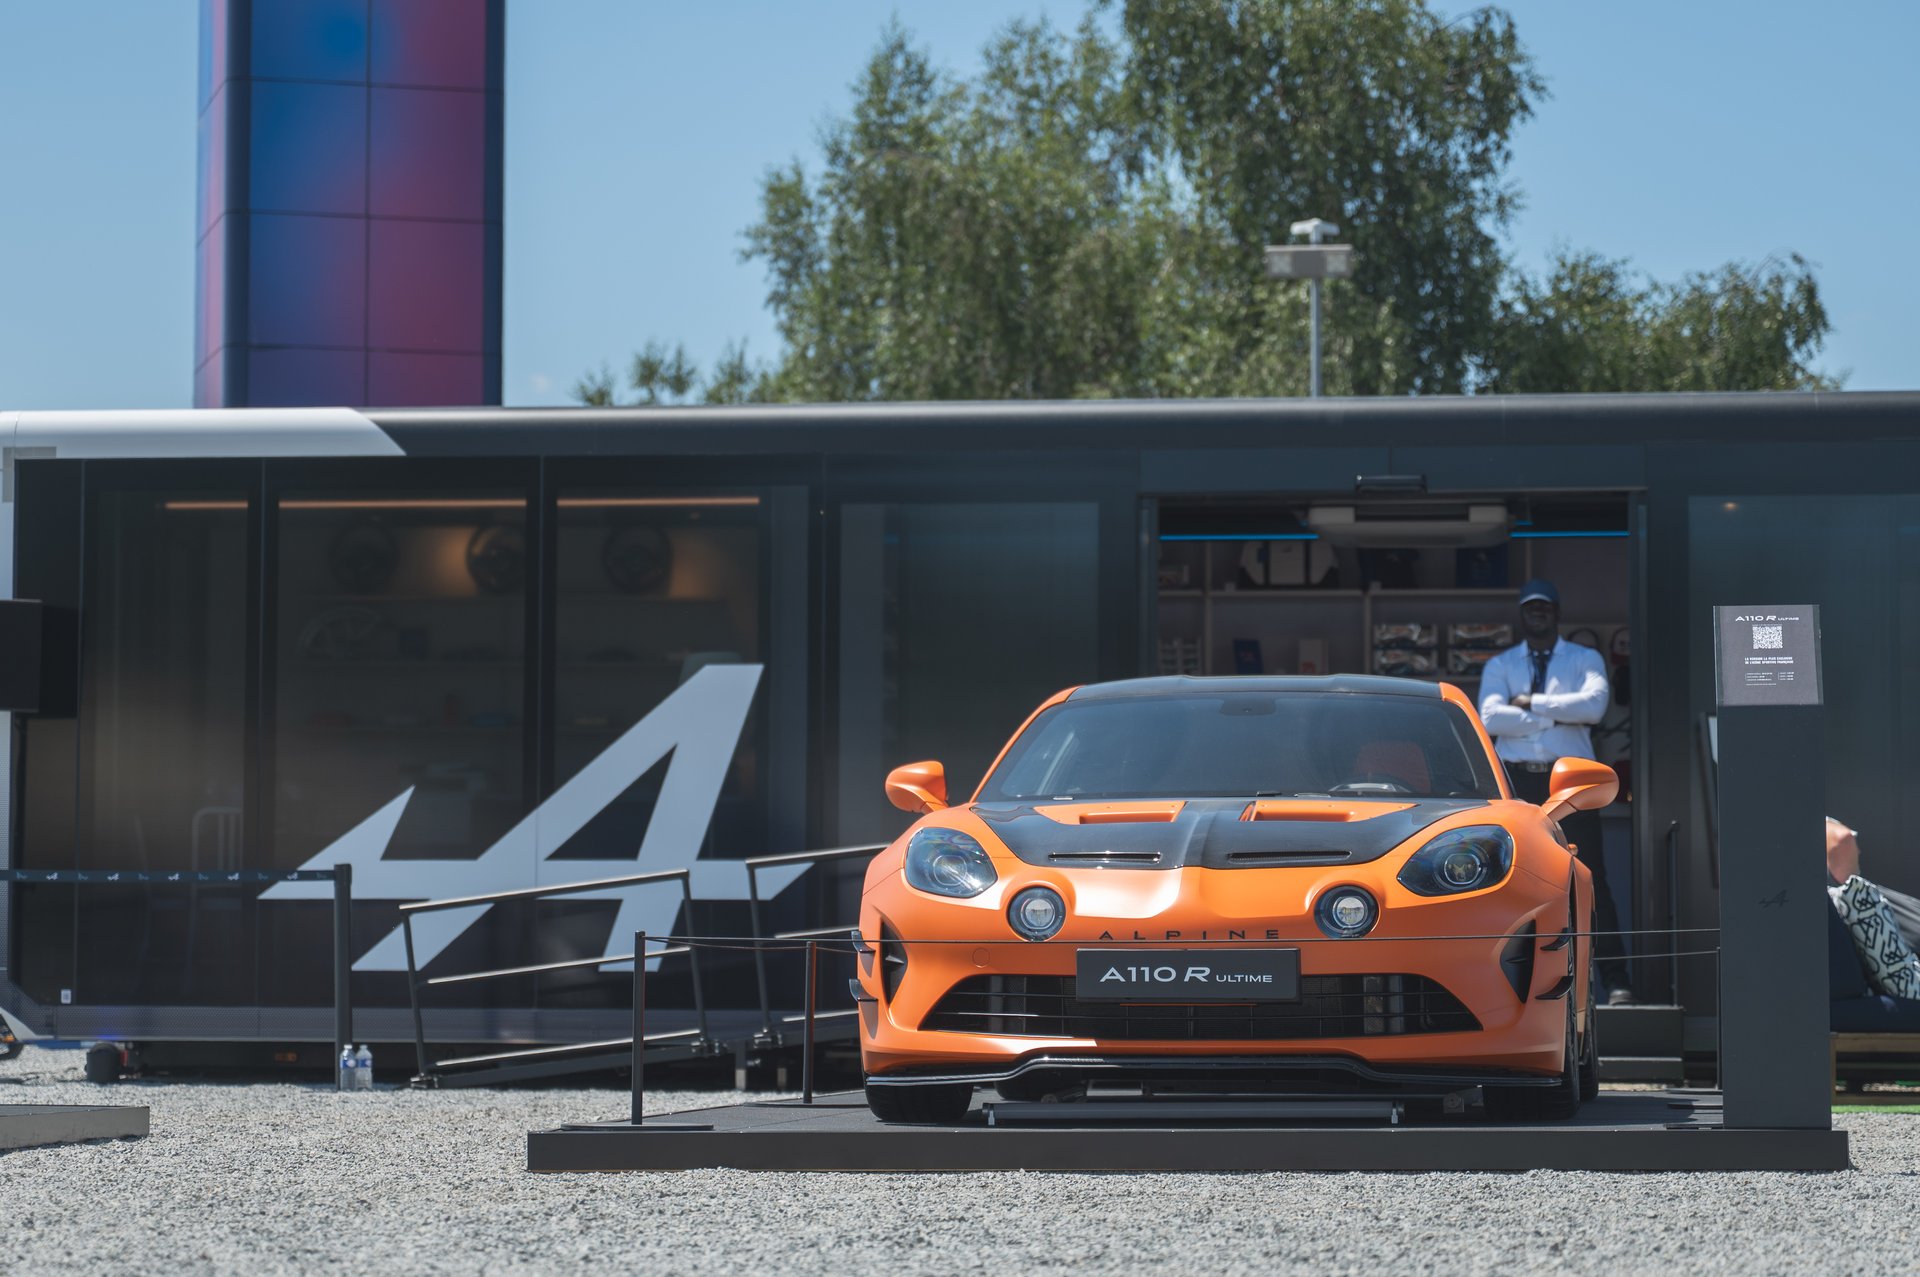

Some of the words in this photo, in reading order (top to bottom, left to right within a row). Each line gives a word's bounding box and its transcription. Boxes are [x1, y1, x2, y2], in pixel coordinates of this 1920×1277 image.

[1098, 929, 1280, 941] ALPINE
[1099, 966, 1177, 983] A110
[1184, 966, 1211, 983] R
[1215, 973, 1273, 983] ULTIME
